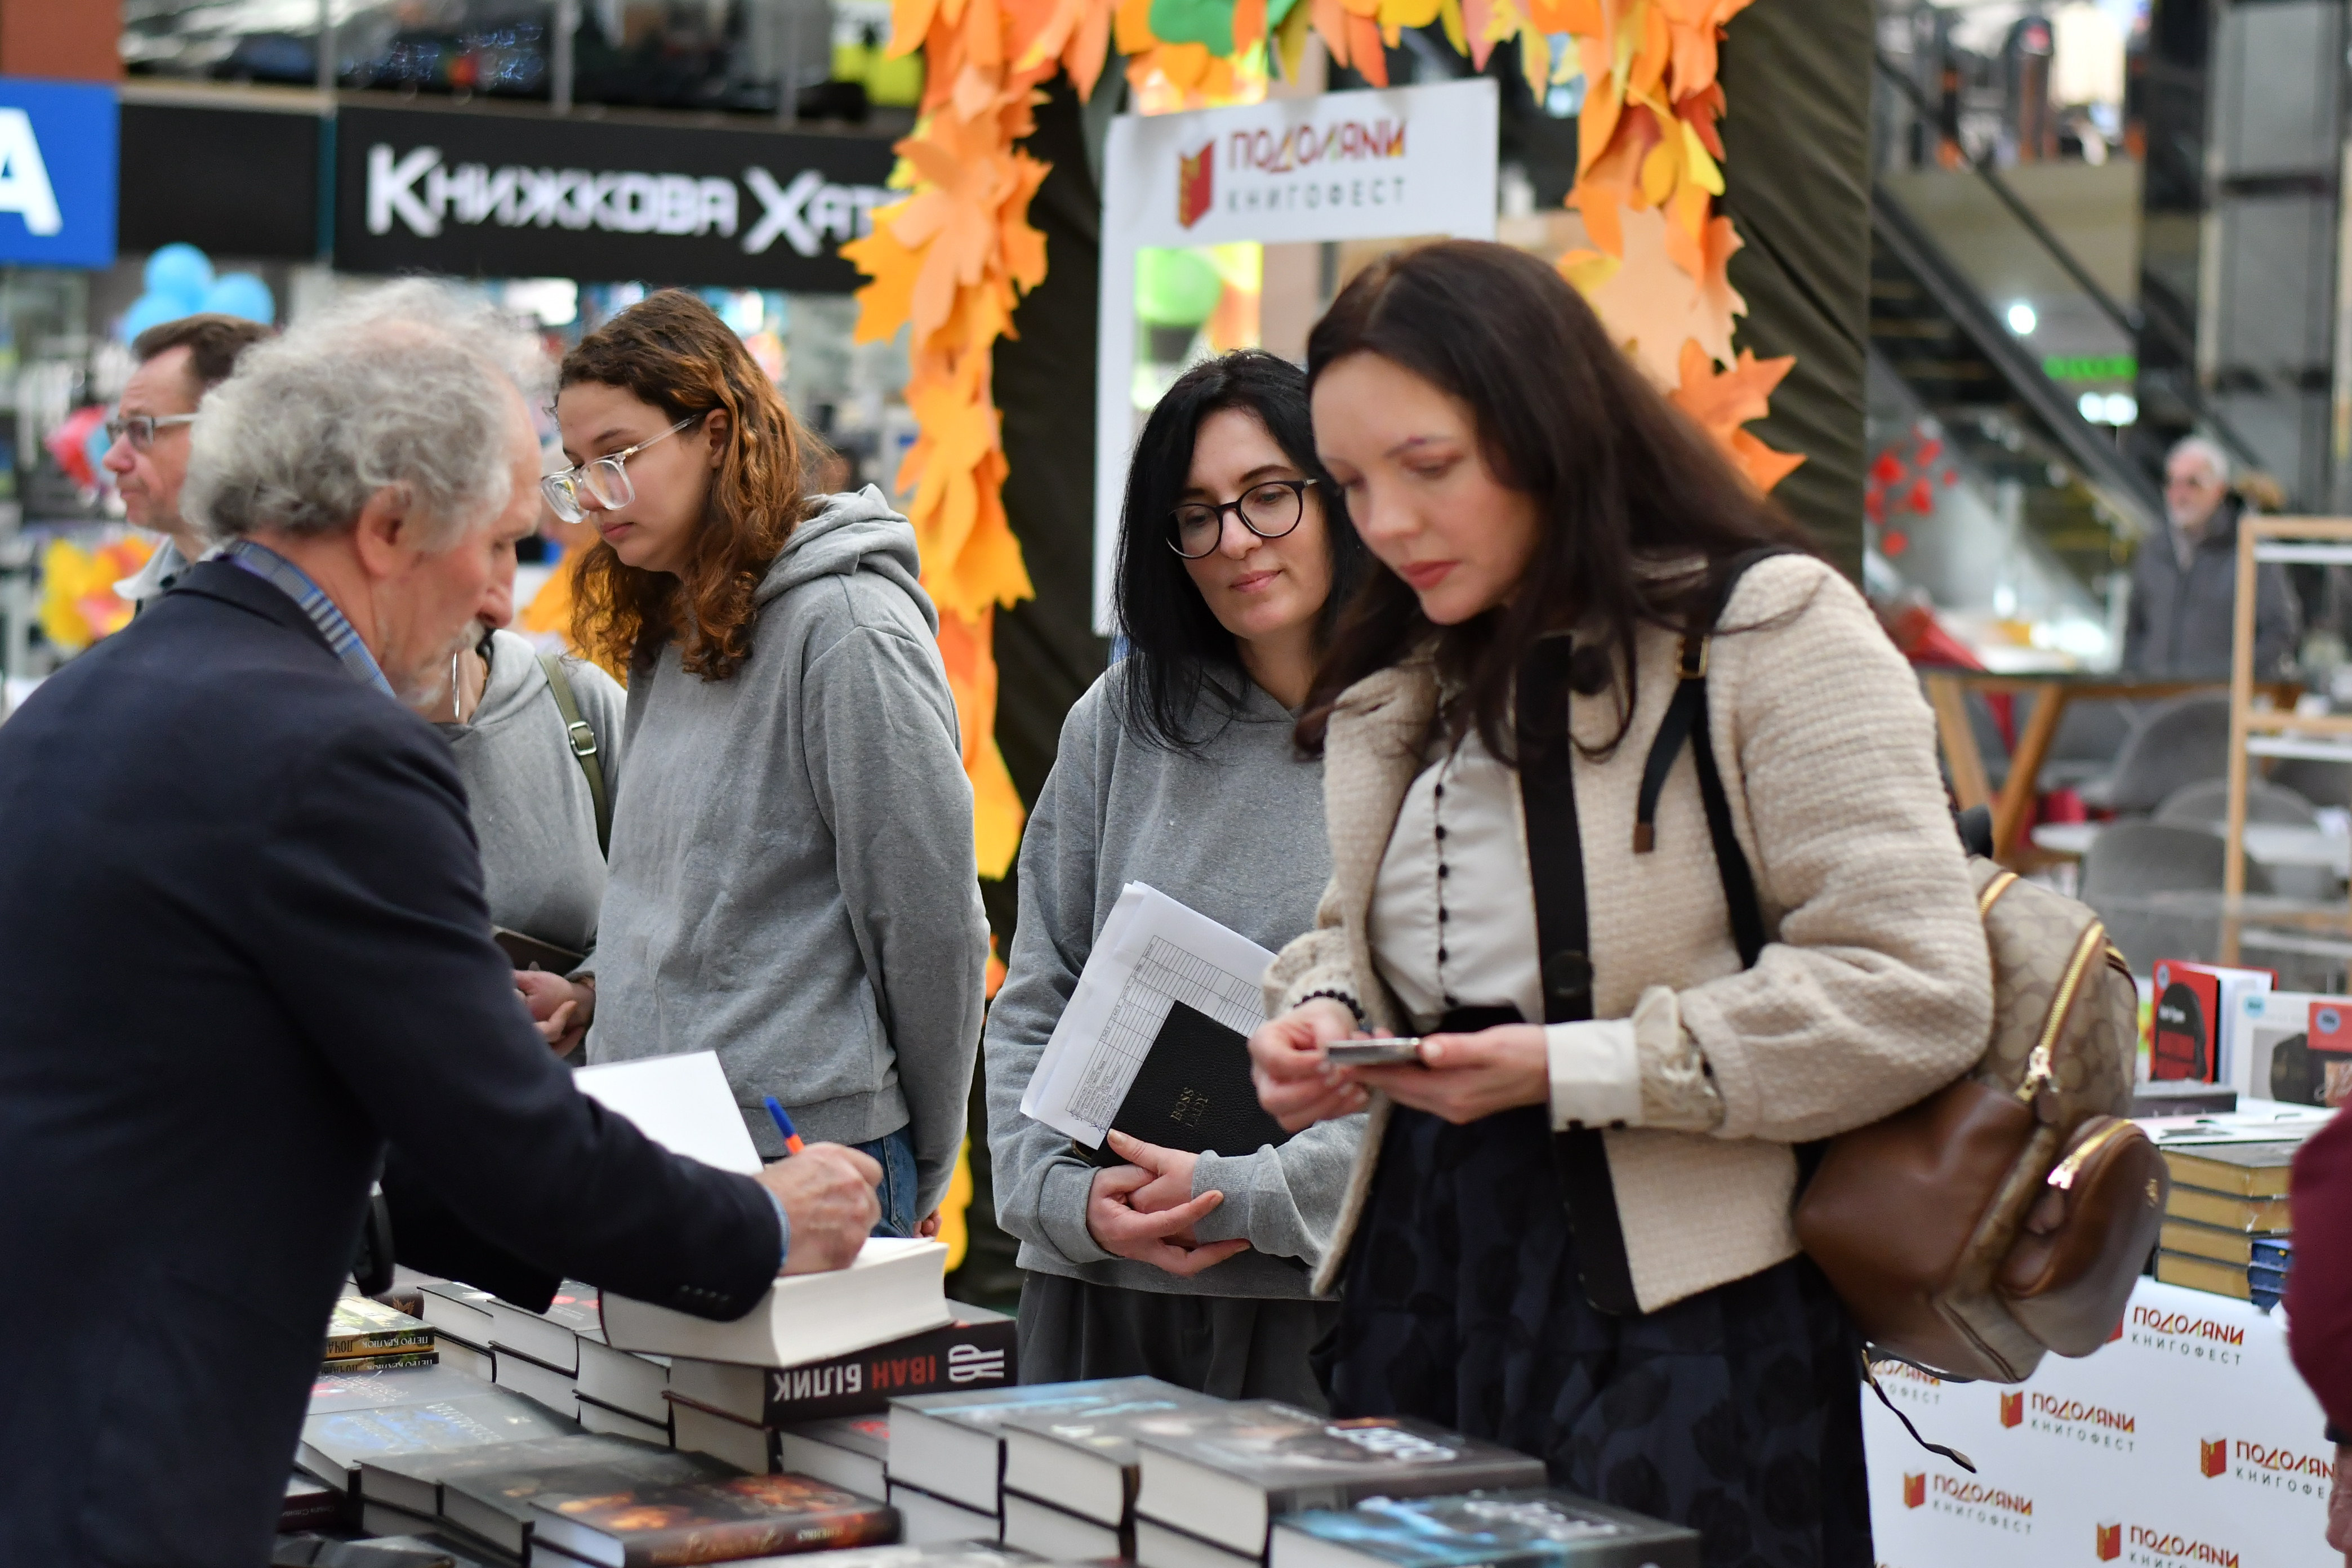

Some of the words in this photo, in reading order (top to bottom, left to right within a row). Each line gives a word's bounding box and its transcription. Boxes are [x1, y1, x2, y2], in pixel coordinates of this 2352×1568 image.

[1228, 176, 1406, 212] КНИГОФЕСТ
[1170, 1088, 1193, 1121] BOSS
[328, 1339, 354, 1354] ПОЧА
[400, 1336, 429, 1346] ПЕТРО
[2132, 1333, 2241, 1365] КНИГОФЕСТ
[773, 1363, 862, 1402] БІЛИК
[871, 1355, 937, 1389] ІВАН
[2031, 1418, 2134, 1452] КНИГОФЕСТ
[2236, 1467, 2325, 1499] КНИГОФЕ
[1933, 1499, 2032, 1535] КНИГОФЕСТ
